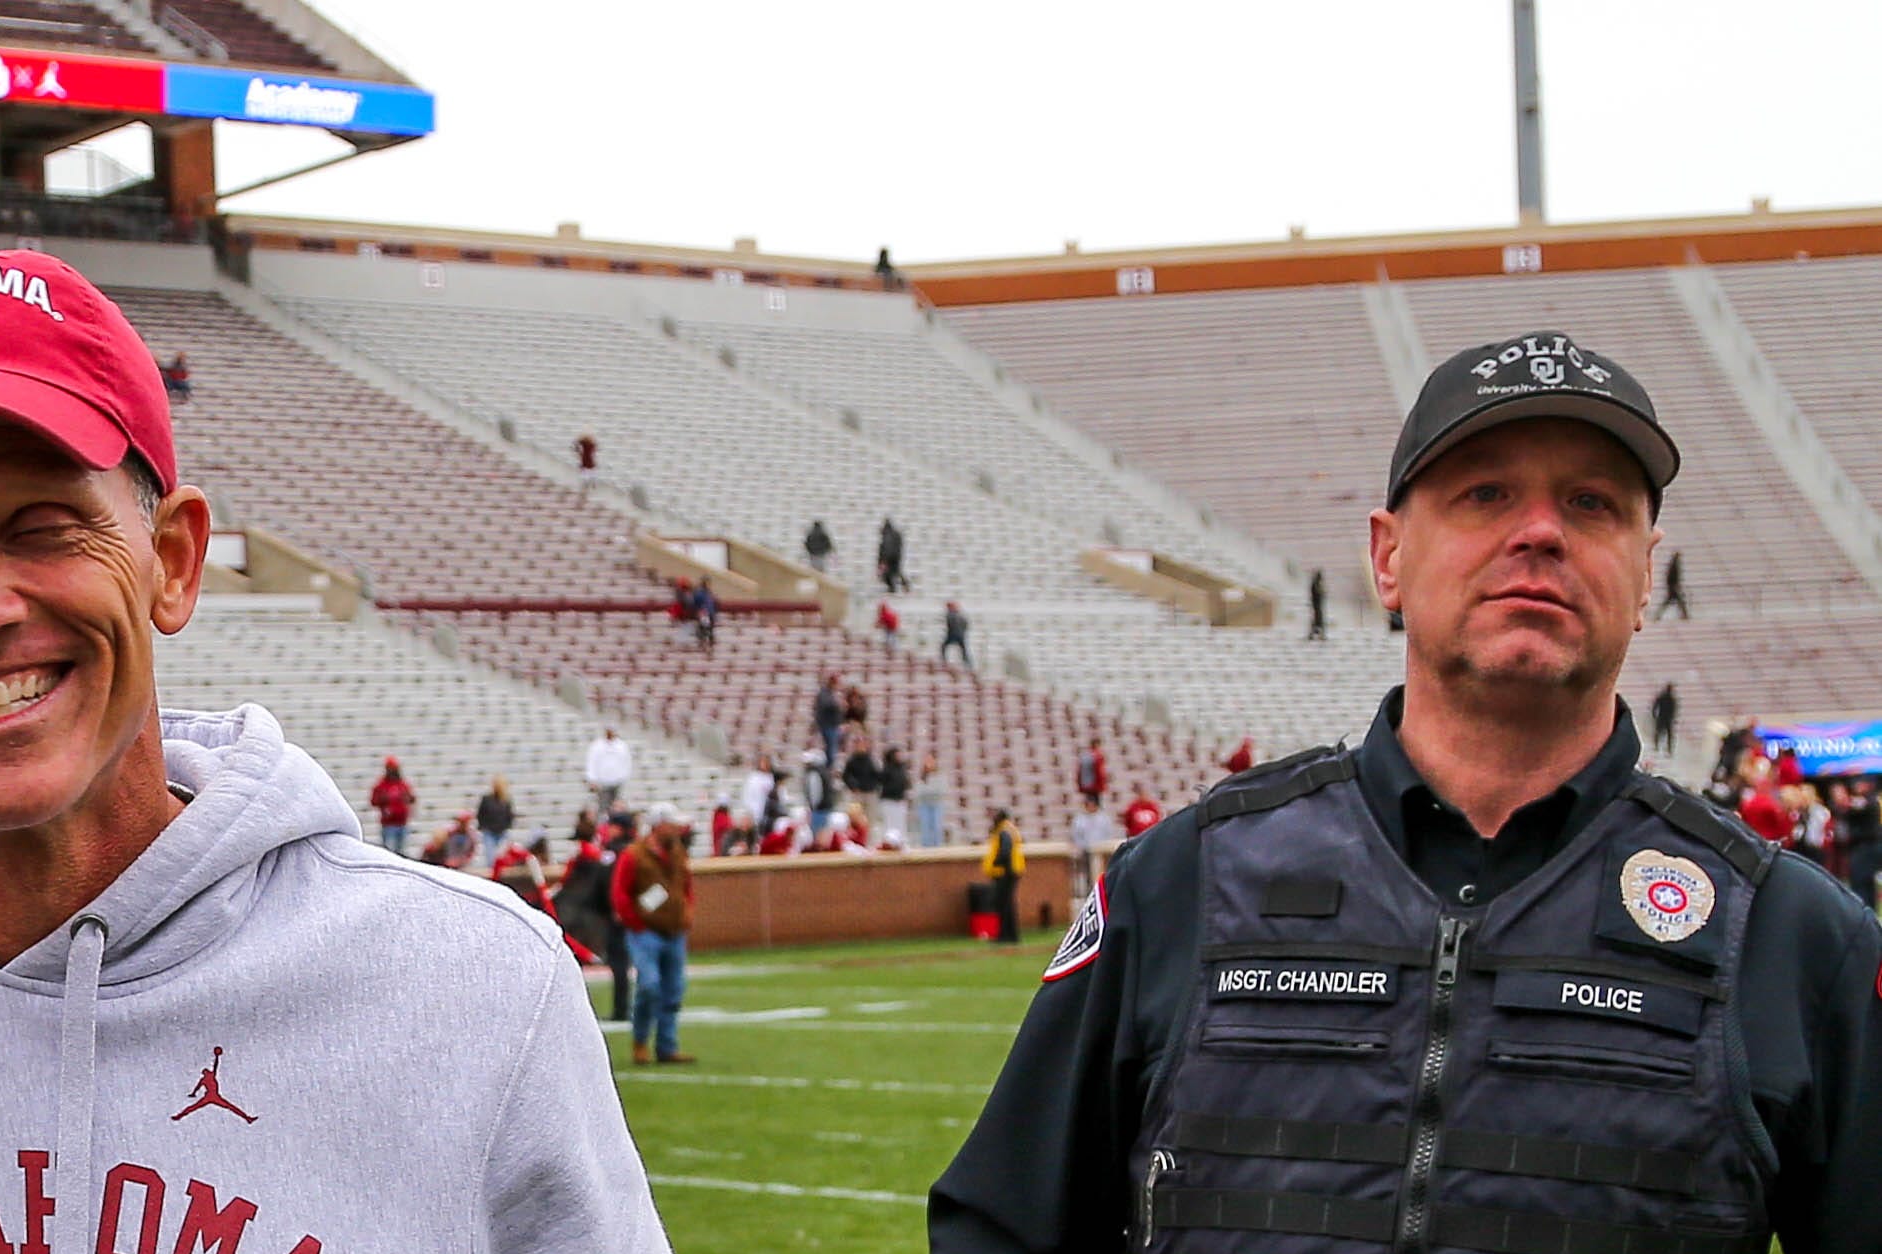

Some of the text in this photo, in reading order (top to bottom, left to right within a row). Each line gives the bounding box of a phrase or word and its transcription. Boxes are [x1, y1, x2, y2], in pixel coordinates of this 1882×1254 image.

[1471, 336, 1611, 384] POLICE
[1530, 357, 1564, 384] OU
[1639, 901, 1693, 924] POLICE
[1218, 970, 1387, 994] MSGT. CHANDLER
[1561, 982, 1643, 1013] POLICE
